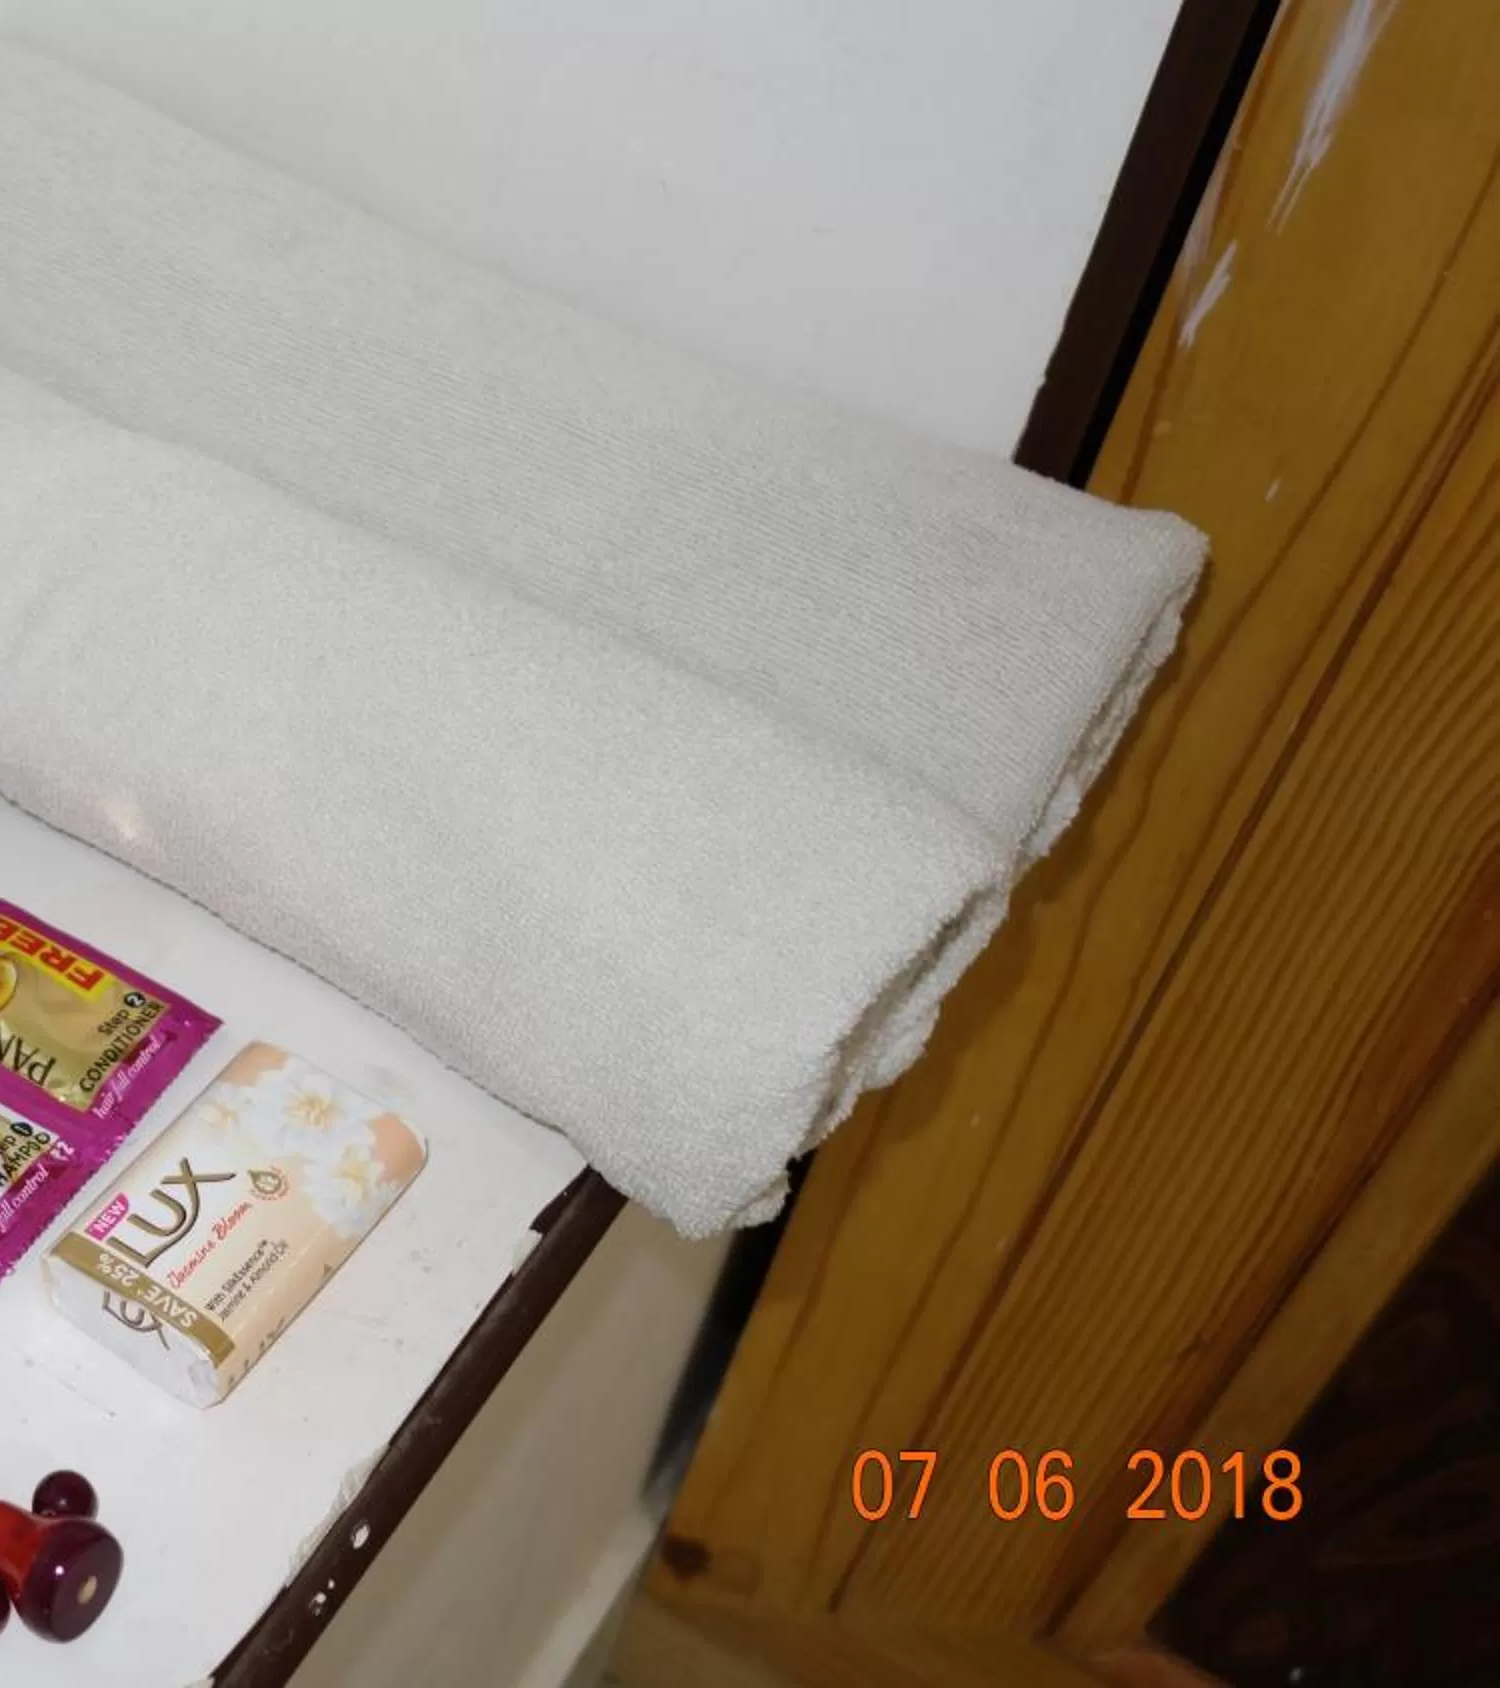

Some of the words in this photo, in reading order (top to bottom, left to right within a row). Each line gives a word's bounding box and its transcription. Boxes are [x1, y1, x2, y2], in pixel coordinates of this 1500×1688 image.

[96, 1009, 129, 1036] Step
[79, 1001, 165, 1092] CONDITIONER
[91, 1092, 115, 1119] hair
[127, 1034, 161, 1078] control
[11, 1163, 49, 1209] control
[92, 1201, 126, 1234] NEW
[105, 1157, 237, 1268] LUX
[96, 1252, 141, 1287] 25%
[166, 1240, 217, 1289] Jasmine
